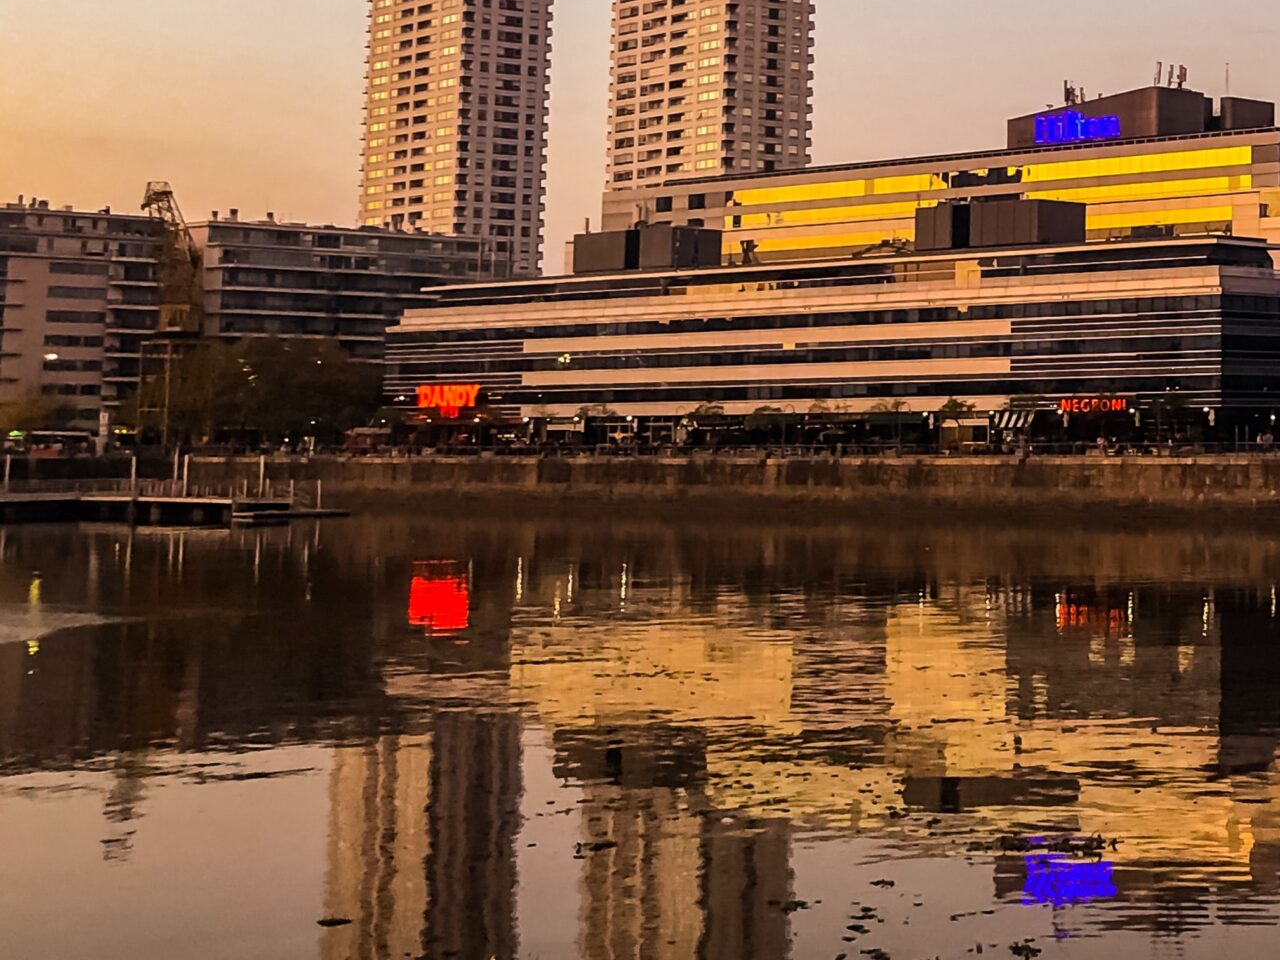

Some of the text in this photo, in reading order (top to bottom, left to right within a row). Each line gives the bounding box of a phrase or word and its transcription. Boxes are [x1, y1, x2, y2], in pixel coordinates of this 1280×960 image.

[1034, 110, 1120, 144] Hilton
[418, 384, 480, 408] DANDY
[1060, 398, 1127, 413] NEGRONI
